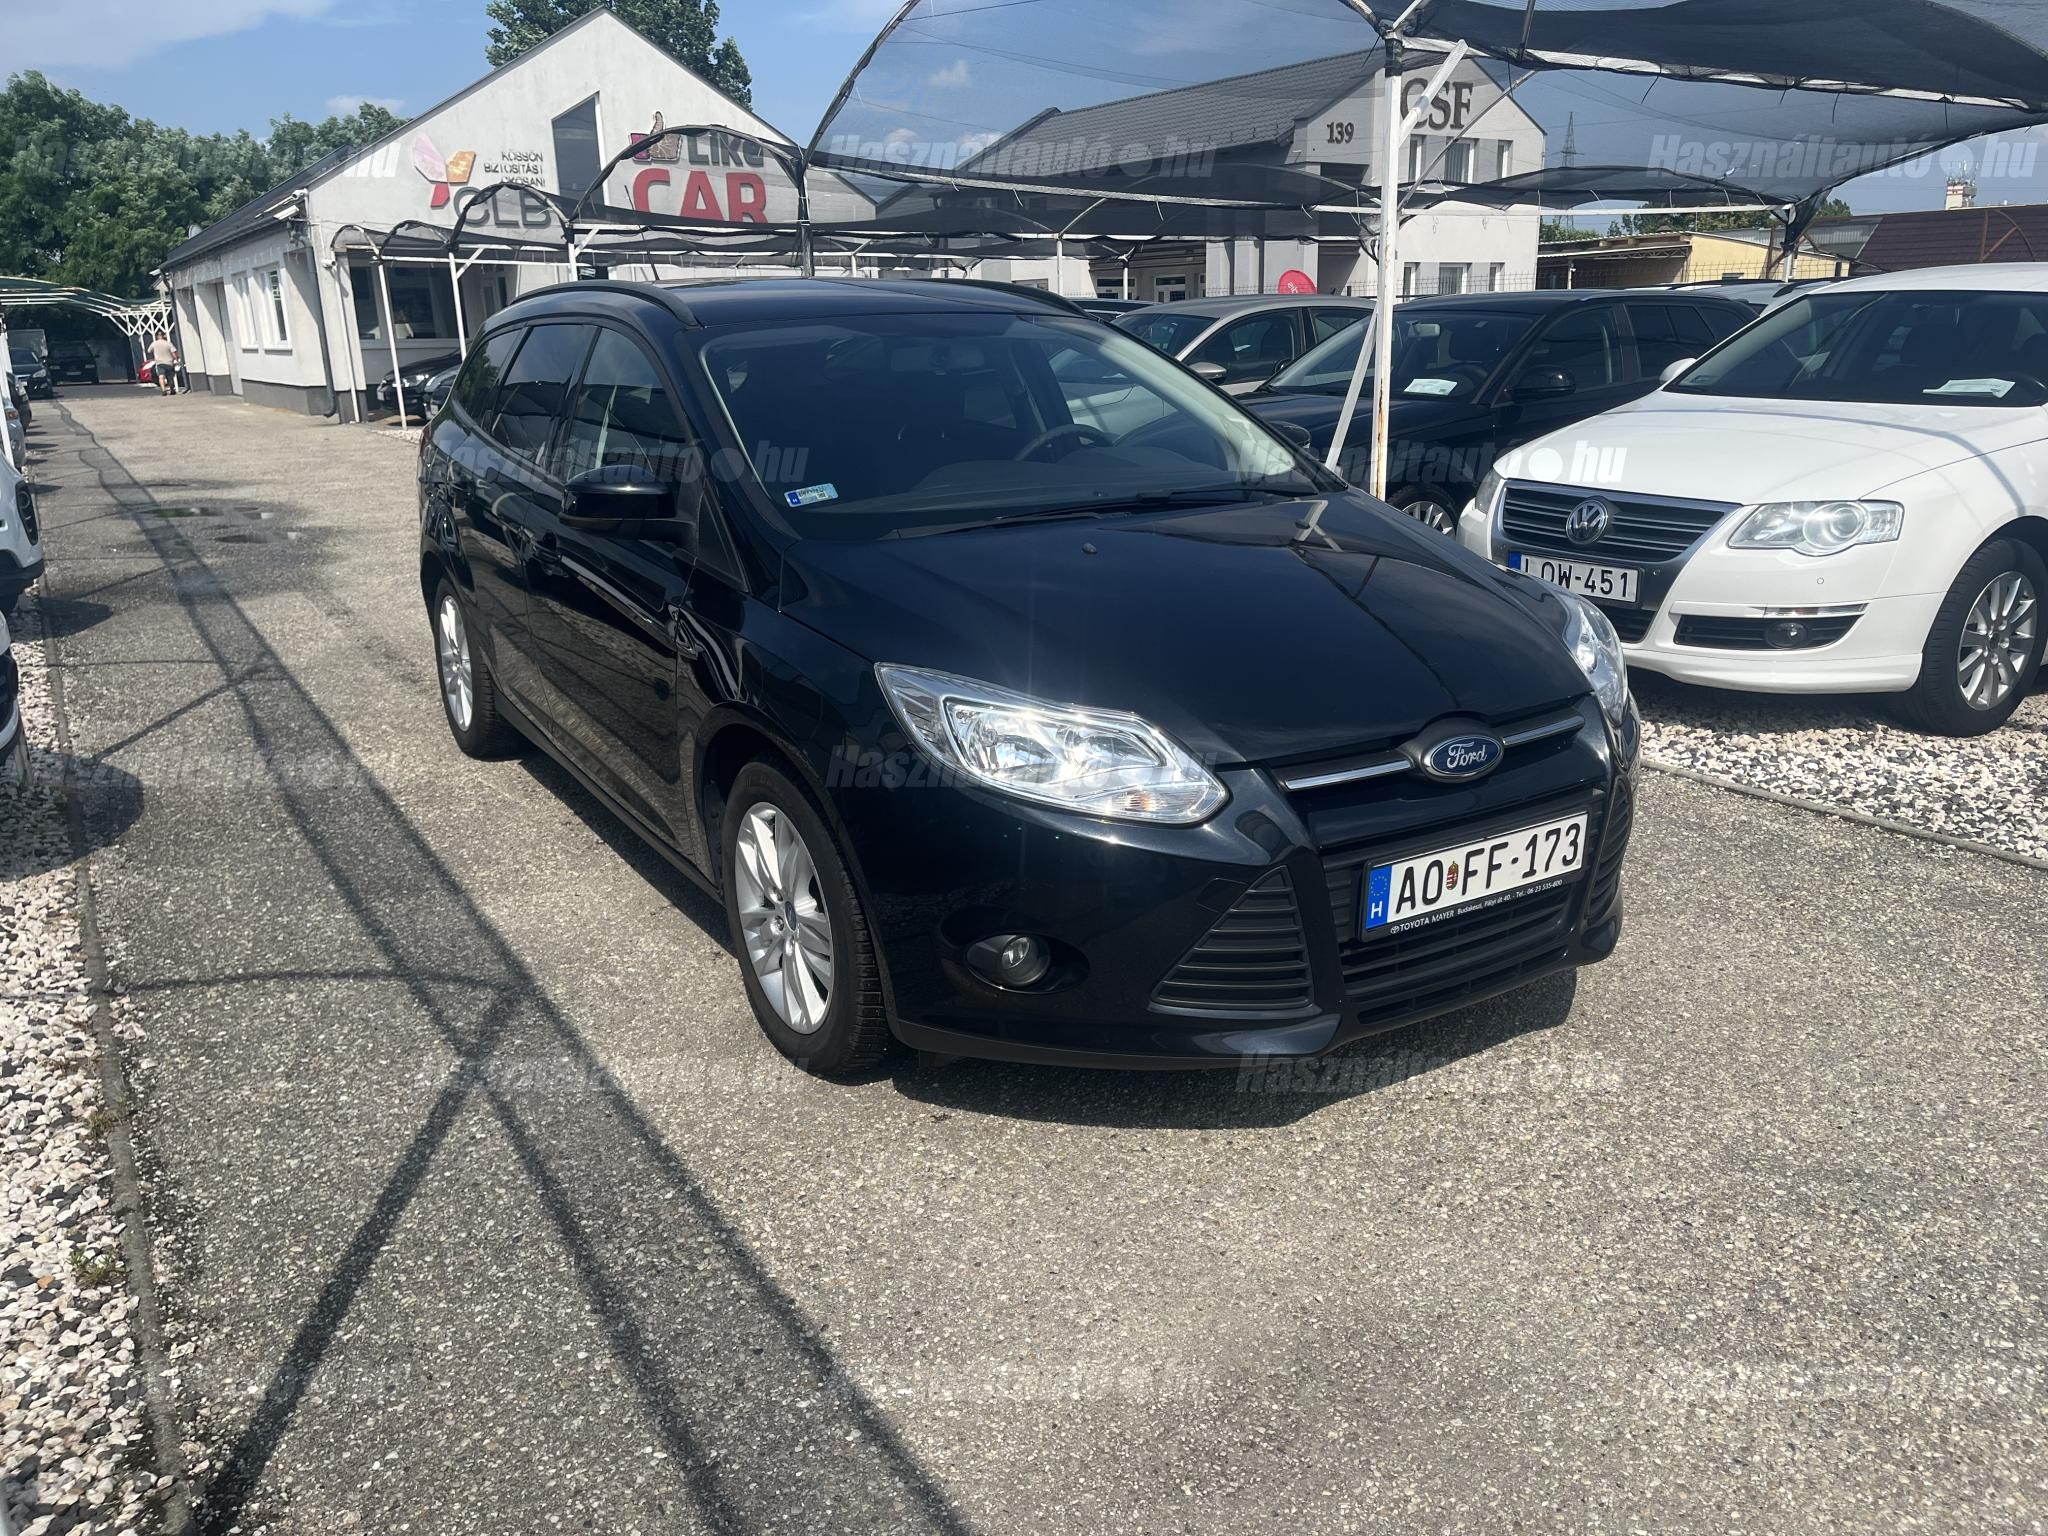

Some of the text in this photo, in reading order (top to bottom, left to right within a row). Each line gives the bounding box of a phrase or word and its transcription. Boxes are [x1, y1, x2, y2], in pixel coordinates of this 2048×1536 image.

[1400, 78, 1473, 131] CSF
[1327, 122, 1354, 144] 139
[454, 186, 551, 229] CLB
[633, 168, 768, 224] CAR
[1447, 741, 1488, 769] Ford
[1369, 900, 1383, 920] H
[1400, 917, 1430, 932] TOYOTA
[1431, 910, 1455, 923] MAYER
